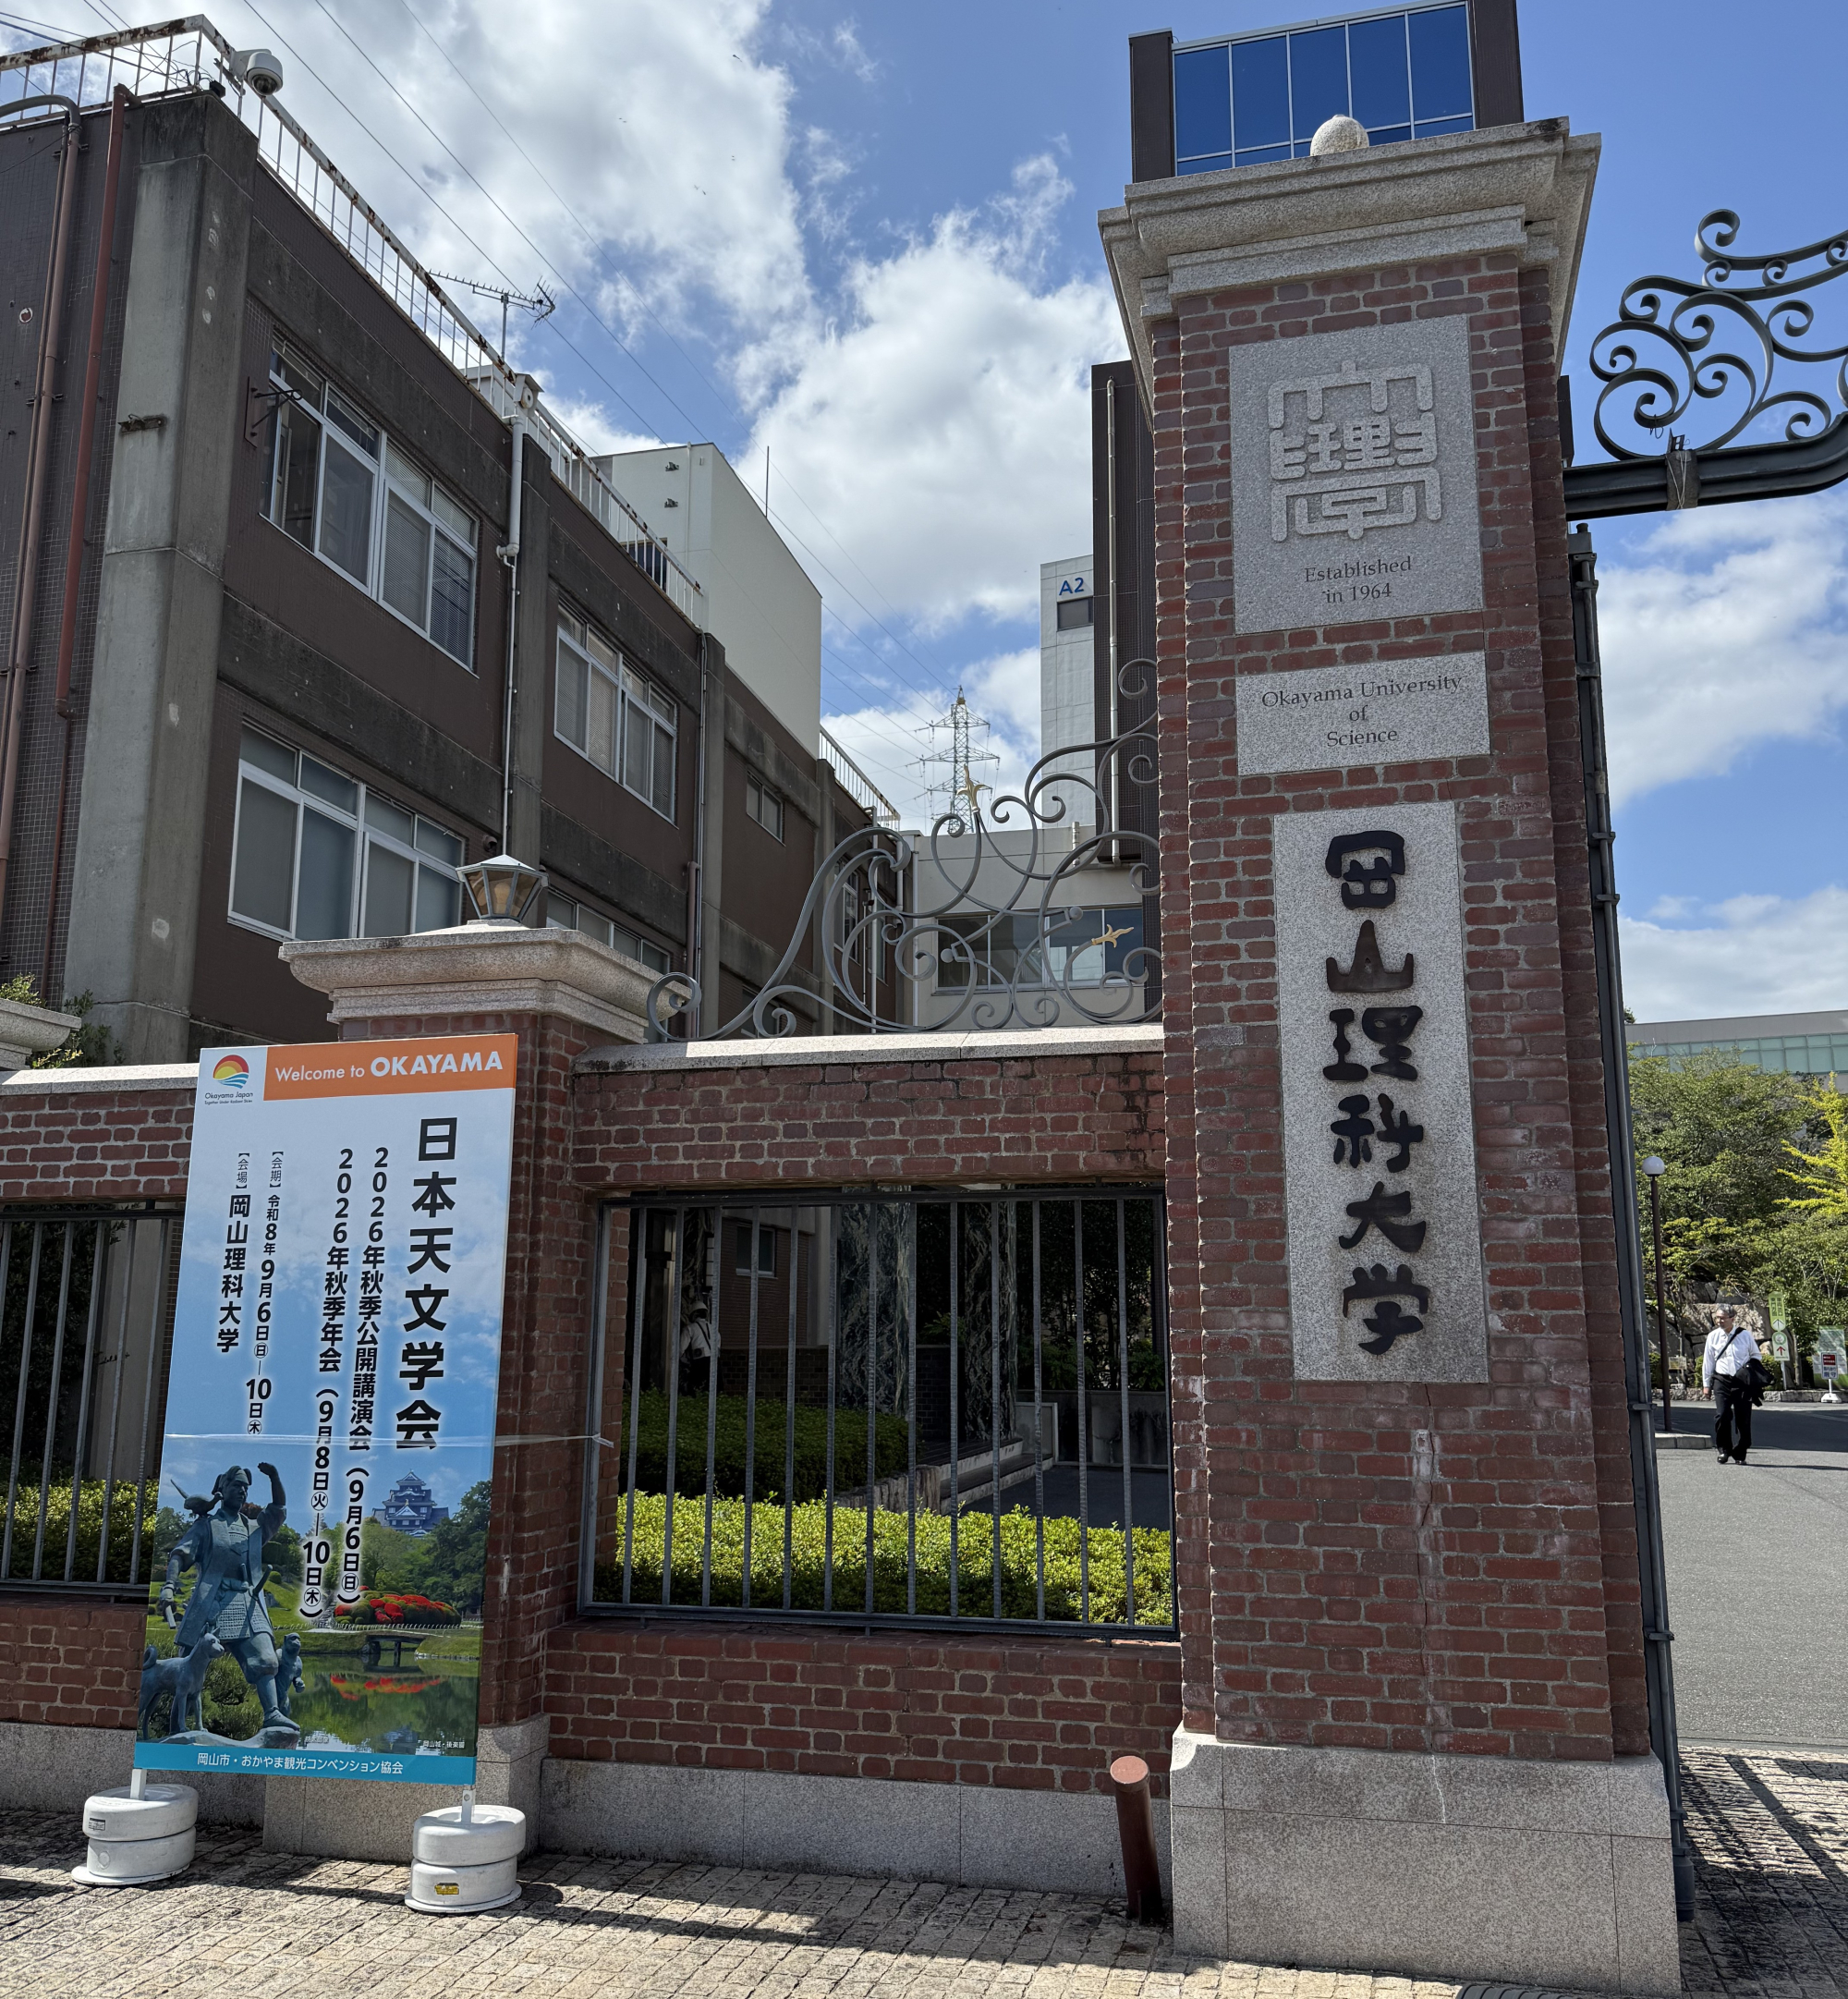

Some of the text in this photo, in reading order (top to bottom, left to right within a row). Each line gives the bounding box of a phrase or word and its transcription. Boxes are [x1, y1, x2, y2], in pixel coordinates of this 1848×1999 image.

[1304, 555, 1412, 583] Established
[1058, 577, 1085, 596] A2
[1324, 582, 1392, 603] in 1964
[1261, 675, 1463, 709] Okayama University
[1348, 704, 1368, 722] of
[1326, 729, 1399, 748] Science
[275, 1051, 504, 1082] Welcome to OKAYAMA
[204, 1091, 254, 1101] Okayama Japan
[1322, 830, 1431, 1357] 岡山理科大学
[395, 1116, 458, 1450] 日本天文学会
